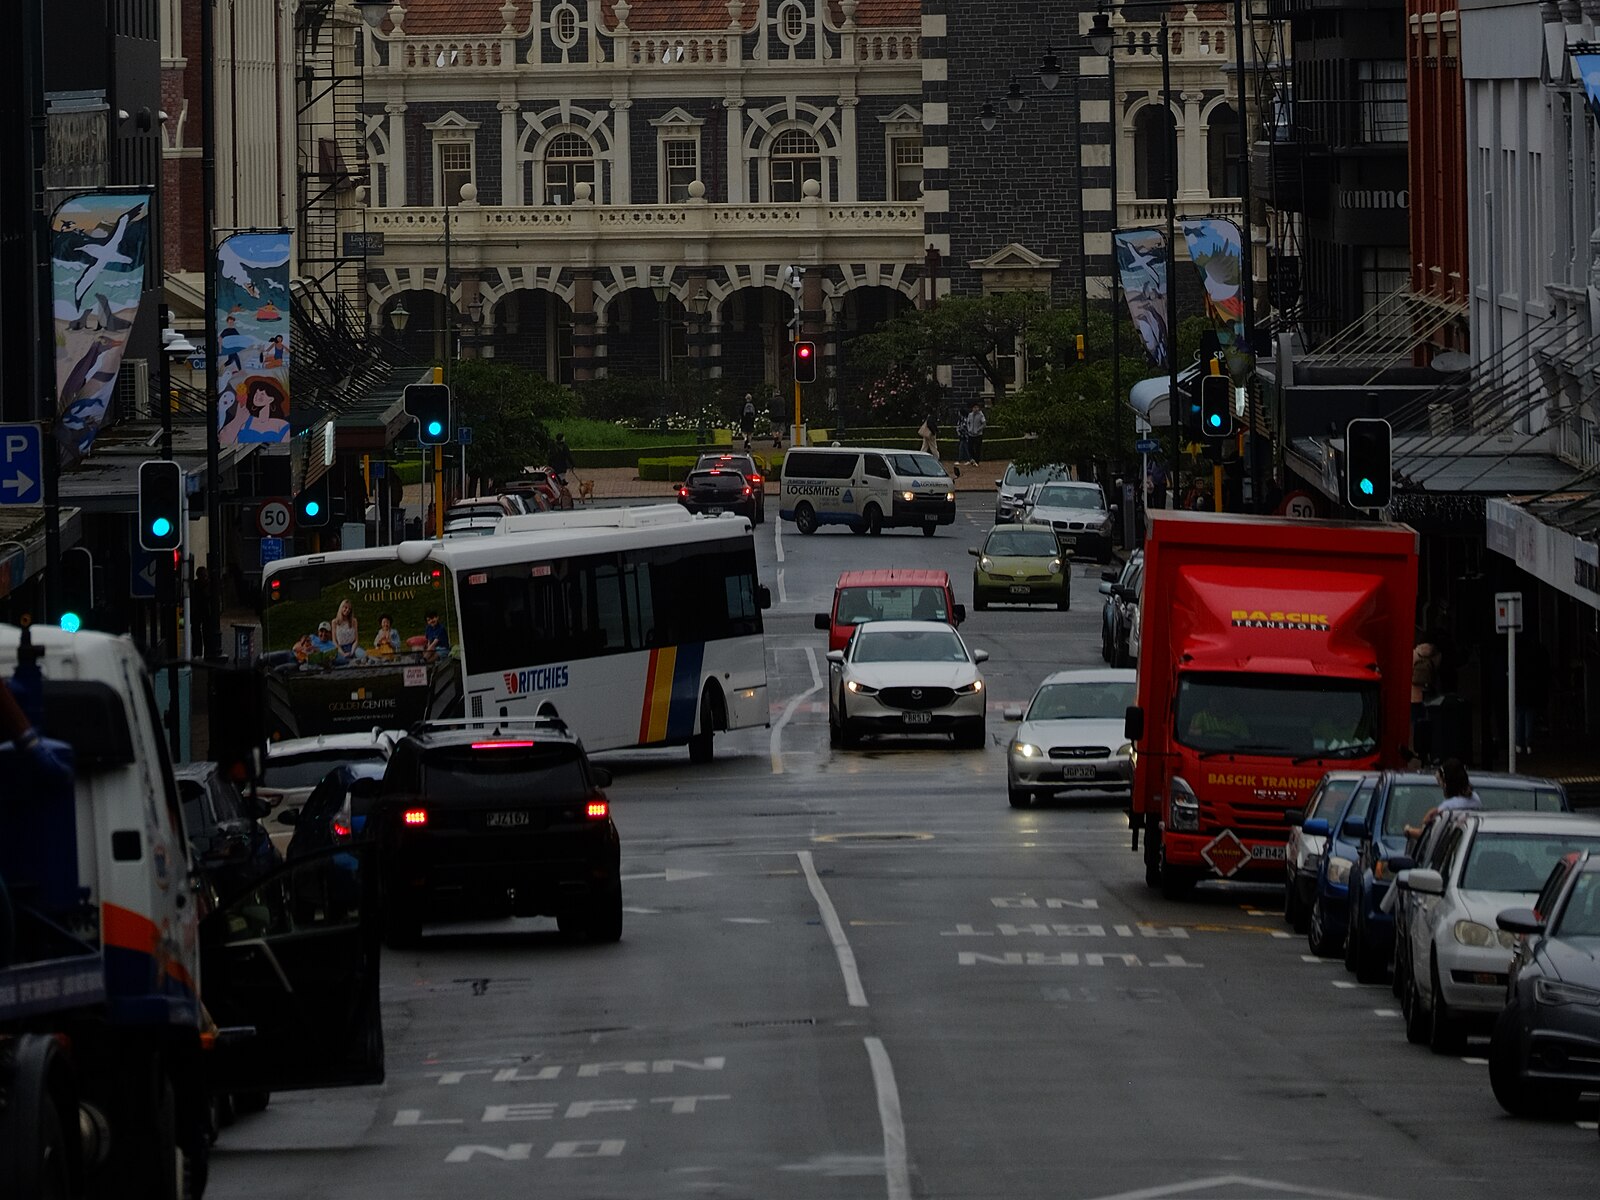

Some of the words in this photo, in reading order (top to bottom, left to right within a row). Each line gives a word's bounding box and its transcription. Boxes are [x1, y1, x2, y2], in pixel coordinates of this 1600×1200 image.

[6, 434, 28, 463] P
[786, 485, 840, 496] LOCKSMITHS
[264, 510, 287, 526] 50
[1292, 503, 1312, 518] 50
[348, 575, 392, 592] Spring
[393, 571, 431, 588] Guide
[364, 591, 385, 602] out
[389, 589, 417, 601] now
[1231, 609, 1329, 625] BASCIK
[1235, 619, 1328, 632] TRANSPORT
[518, 665, 569, 693] RITCHIES
[1207, 773, 1257, 786] BASCIK
[957, 951, 1206, 969] TURN
[424, 1056, 726, 1086] TURN
[393, 1094, 732, 1127] LEFT
[444, 1139, 627, 1164] NO
